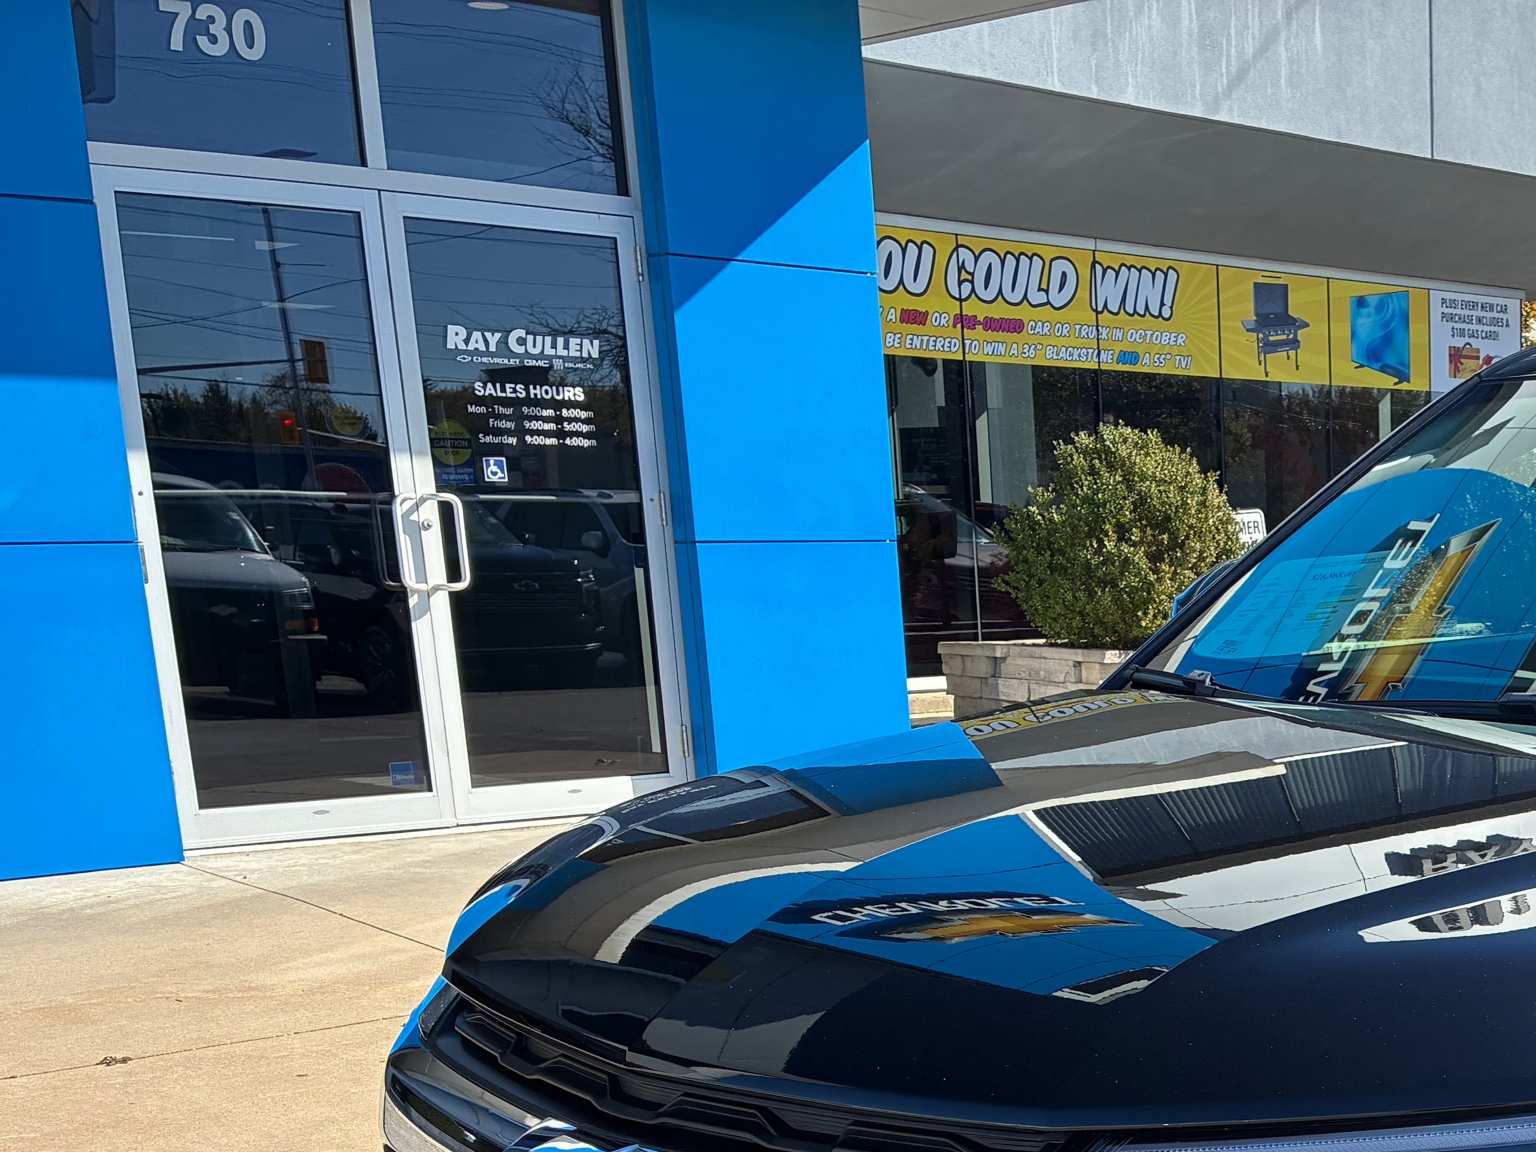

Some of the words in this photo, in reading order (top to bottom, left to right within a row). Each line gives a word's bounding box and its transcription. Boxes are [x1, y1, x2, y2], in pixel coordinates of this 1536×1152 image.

[158, 0, 266, 60] 730
[944, 243, 1079, 311] COULD
[1090, 260, 1180, 321] WIN!
[1441, 298, 1459, 310] PLUS!
[1460, 299, 1479, 311] EVERY
[1480, 301, 1495, 314] NEW
[1495, 303, 1509, 314] CAR
[886, 307, 897, 323] A
[900, 308, 929, 326] NEW
[931, 311, 950, 328] OR
[952, 313, 1025, 334] PRE-OWNED
[1027, 319, 1051, 336] CAR
[1054, 323, 1071, 338] OR
[1074, 324, 1110, 341] TRUCK
[1112, 328, 1124, 342] IN
[1127, 329, 1187, 347] OCTOBER
[1441, 312, 1474, 325] PURCHASE
[1475, 315, 1504, 328] INCLUDES
[1504, 318, 1510, 328] A
[446, 324, 502, 352] RAY
[507, 328, 600, 358] CULLEN
[1450, 326, 1466, 338] $100
[1467, 328, 1480, 339] GAS
[1480, 329, 1500, 341] CARD!
[885, 332, 903, 349] BE
[905, 333, 960, 353] ENTERED
[964, 339, 981, 355] TO
[983, 340, 1007, 357] WIN
[1009, 342, 1019, 358] A
[1045, 345, 1115, 364] BLACKSTONE
[1116, 352, 1140, 366] AND
[1142, 353, 1151, 367] A
[1174, 355, 1193, 370] TV!
[473, 356, 520, 366] CHEVROLET
[523, 359, 550, 368] GMC
[564, 362, 595, 370] BUICK
[474, 381, 526, 398] SALES
[529, 384, 585, 401] HOURS
[467, 404, 487, 414] Mon
[493, 405, 514, 415] Thur
[522, 406, 555, 417] 9:00am
[561, 409, 594, 420] 8:00pm
[489, 419, 516, 430] Friday
[523, 420, 557, 431] 9:00am
[563, 423, 596, 434] 5:00pm
[433, 439, 468, 448] CAUTION
[478, 433, 518, 446] Saturday
[525, 435, 558, 446] 9:00am
[565, 437, 597, 449] 4:00pm
